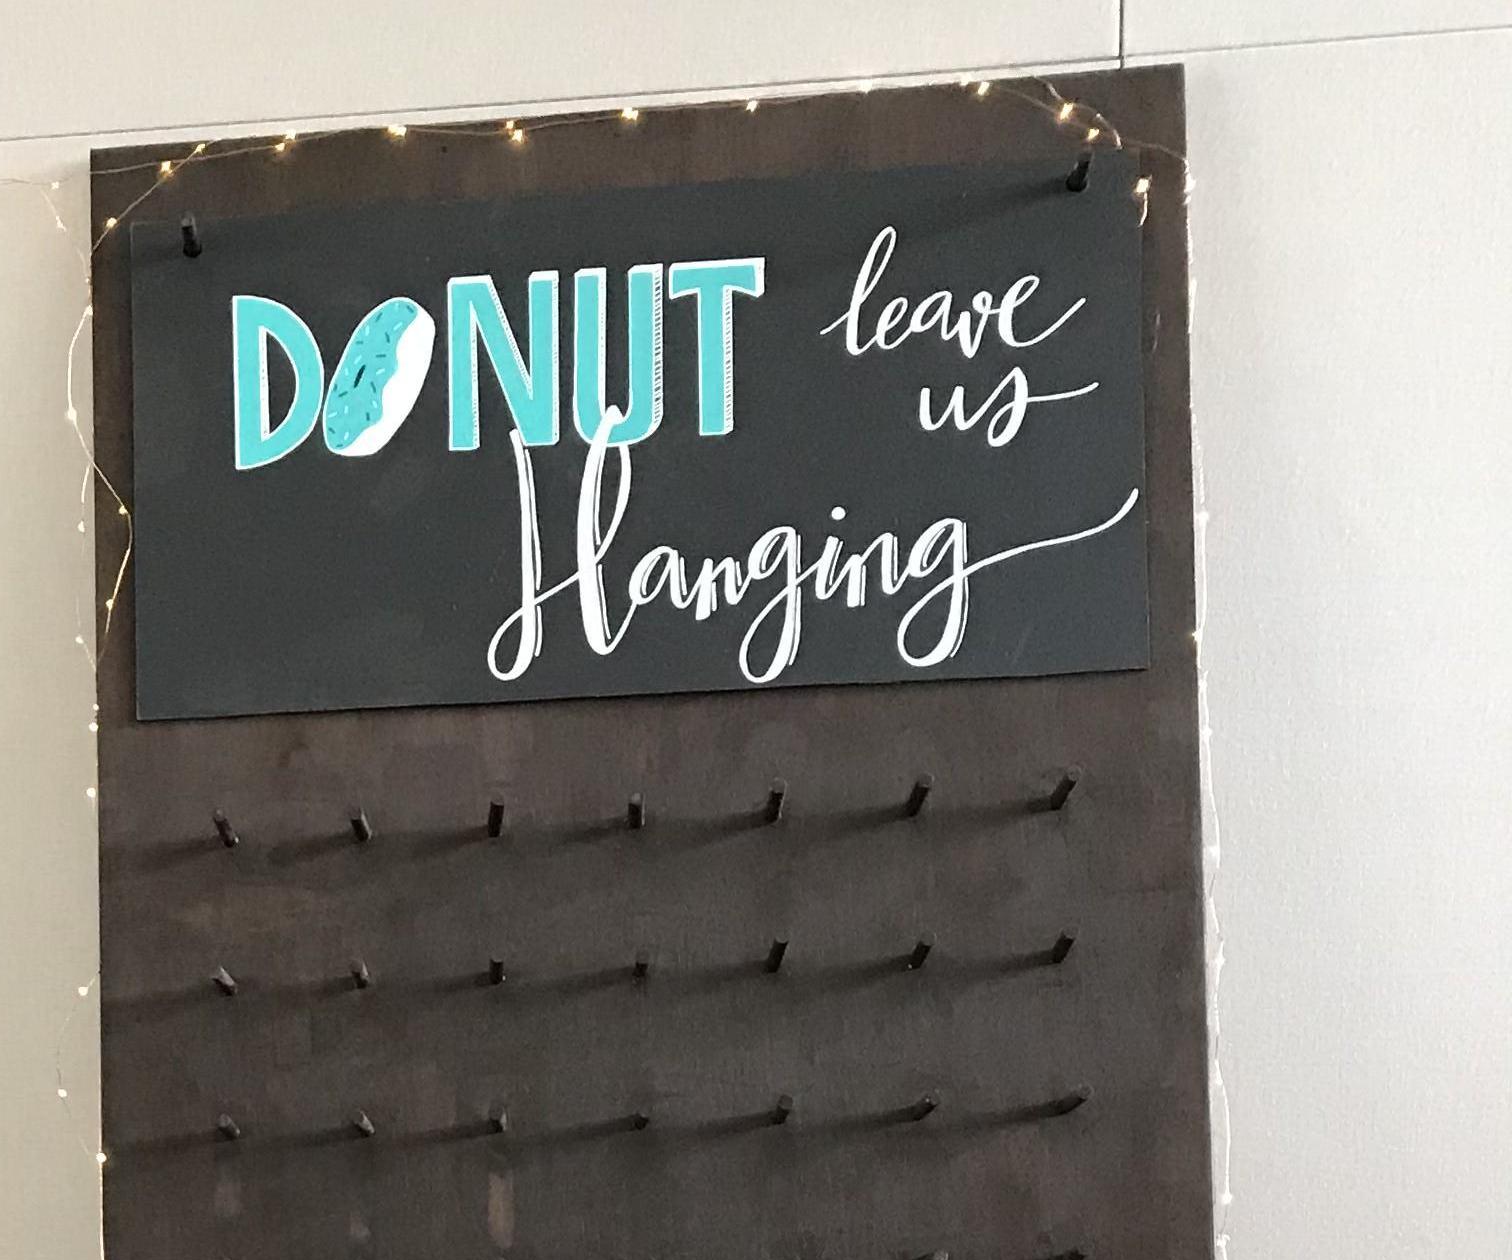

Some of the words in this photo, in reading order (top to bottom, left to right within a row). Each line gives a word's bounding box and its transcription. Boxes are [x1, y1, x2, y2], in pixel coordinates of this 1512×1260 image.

[232, 257, 765, 470] DONUT
[820, 226, 1086, 359] leave
[919, 368, 1099, 447] us
[488, 405, 1138, 683] Hanging
